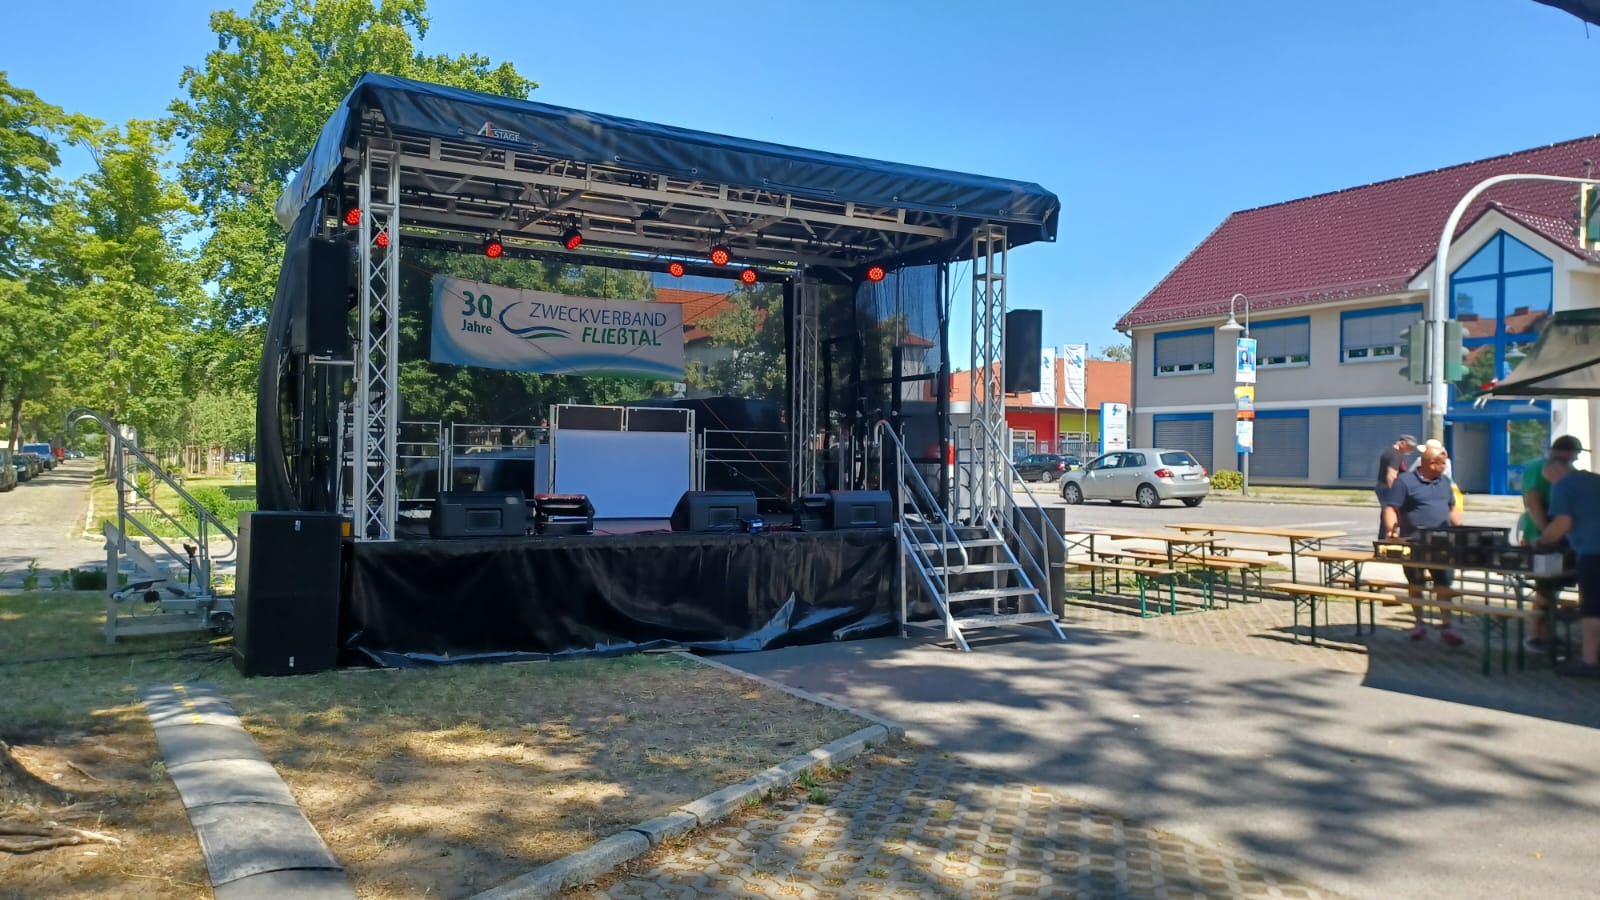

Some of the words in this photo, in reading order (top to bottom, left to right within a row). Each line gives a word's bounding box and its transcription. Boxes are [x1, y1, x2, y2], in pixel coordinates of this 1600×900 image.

[461, 290, 493, 319] 30
[529, 302, 667, 328] ZWECKVERBAND
[461, 319, 493, 335] Jahre
[581, 326, 662, 347] FLIEßTAL
